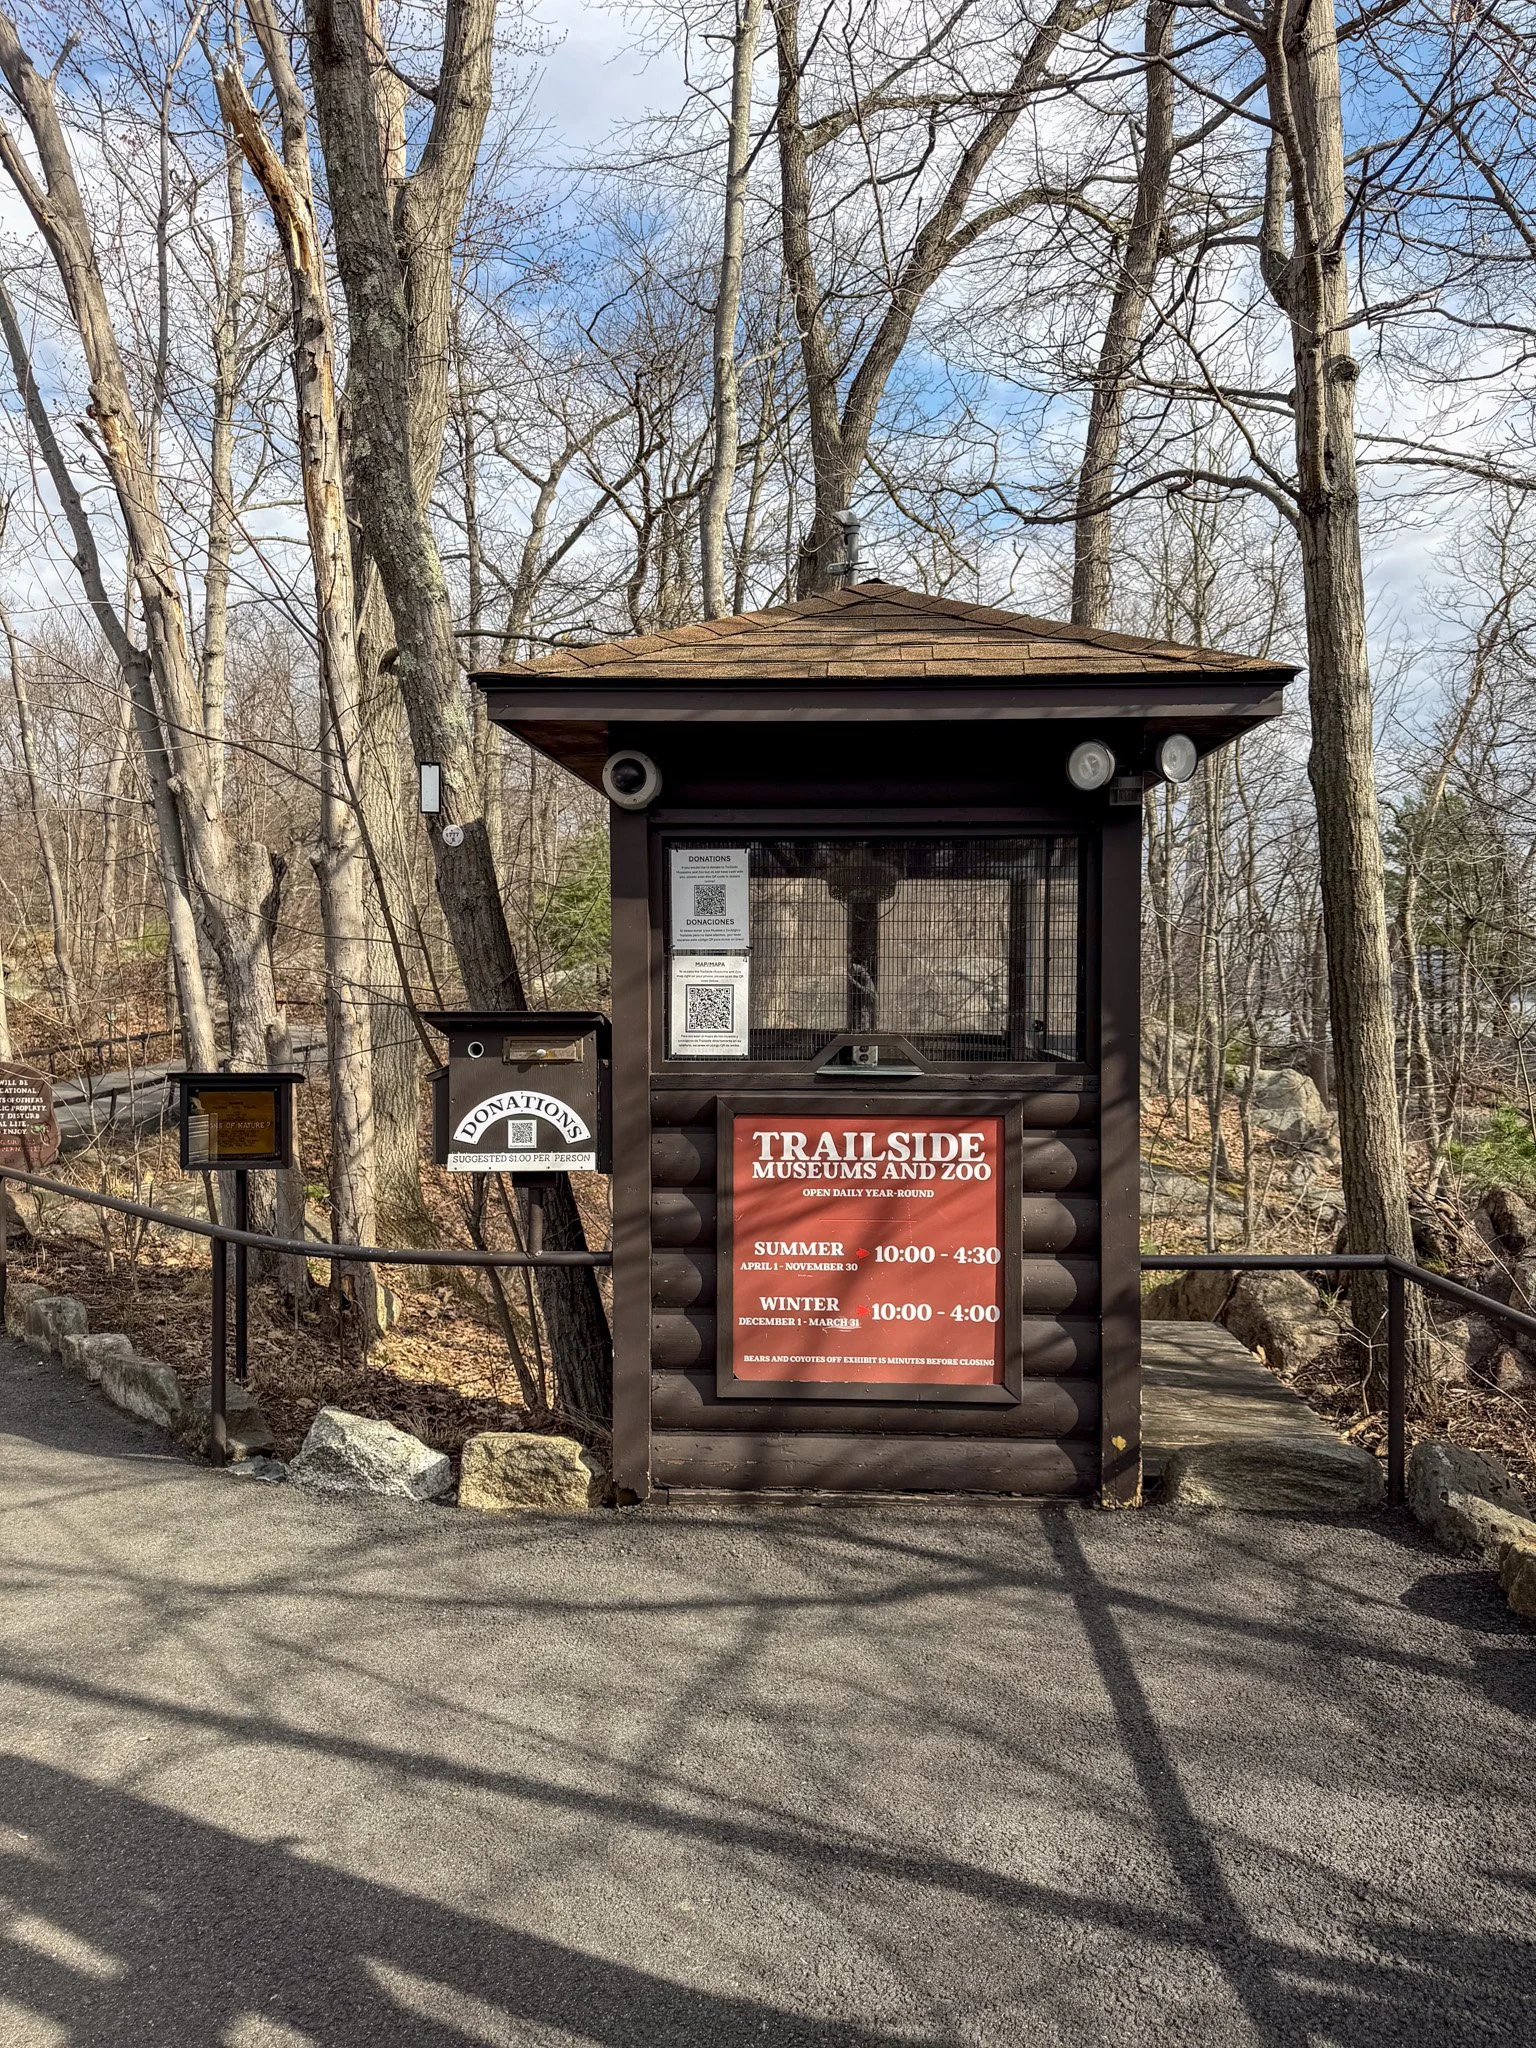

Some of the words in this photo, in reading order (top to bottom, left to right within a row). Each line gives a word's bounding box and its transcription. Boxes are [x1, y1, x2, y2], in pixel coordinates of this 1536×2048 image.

[461, 1095, 583, 1139] DONATIONS
[752, 1131, 986, 1162] TRAILSIDE
[453, 1155, 507, 1163] SUGGESTED
[509, 1154, 531, 1163] $1.00
[533, 1154, 550, 1162] PER
[554, 1153, 591, 1162] PERSON
[752, 1161, 877, 1179] MUSEUMS
[882, 1162, 936, 1180] AND
[940, 1162, 992, 1181] ZOO
[802, 1188, 831, 1197] OPEN
[833, 1188, 863, 1198] DAILY
[864, 1189, 935, 1198] YEAR-ROUND
[754, 1241, 844, 1257] SUMMER
[874, 1245, 936, 1264] 10:00
[953, 1246, 1001, 1265] 4:30
[740, 1262, 772, 1271] APRIL
[773, 1262, 779, 1271] 1
[785, 1262, 845, 1271] NOVEMBER
[845, 1262, 858, 1272] 30
[759, 1296, 840, 1312] WINTER
[871, 1303, 933, 1321] 10:00
[950, 1304, 1001, 1323] 4:00
[738, 1317, 796, 1326] DECEMBER
[797, 1318, 802, 1326] 1
[809, 1317, 849, 1327] MARCH
[849, 1318, 860, 1327] 31
[771, 1355, 789, 1363] AND
[790, 1355, 826, 1363] COYOTES
[843, 1356, 877, 1364] EXHIBIT
[887, 1357, 925, 1365] MINUTES
[926, 1358, 959, 1366] BEFORE
[959, 1358, 995, 1366] CLOSING
